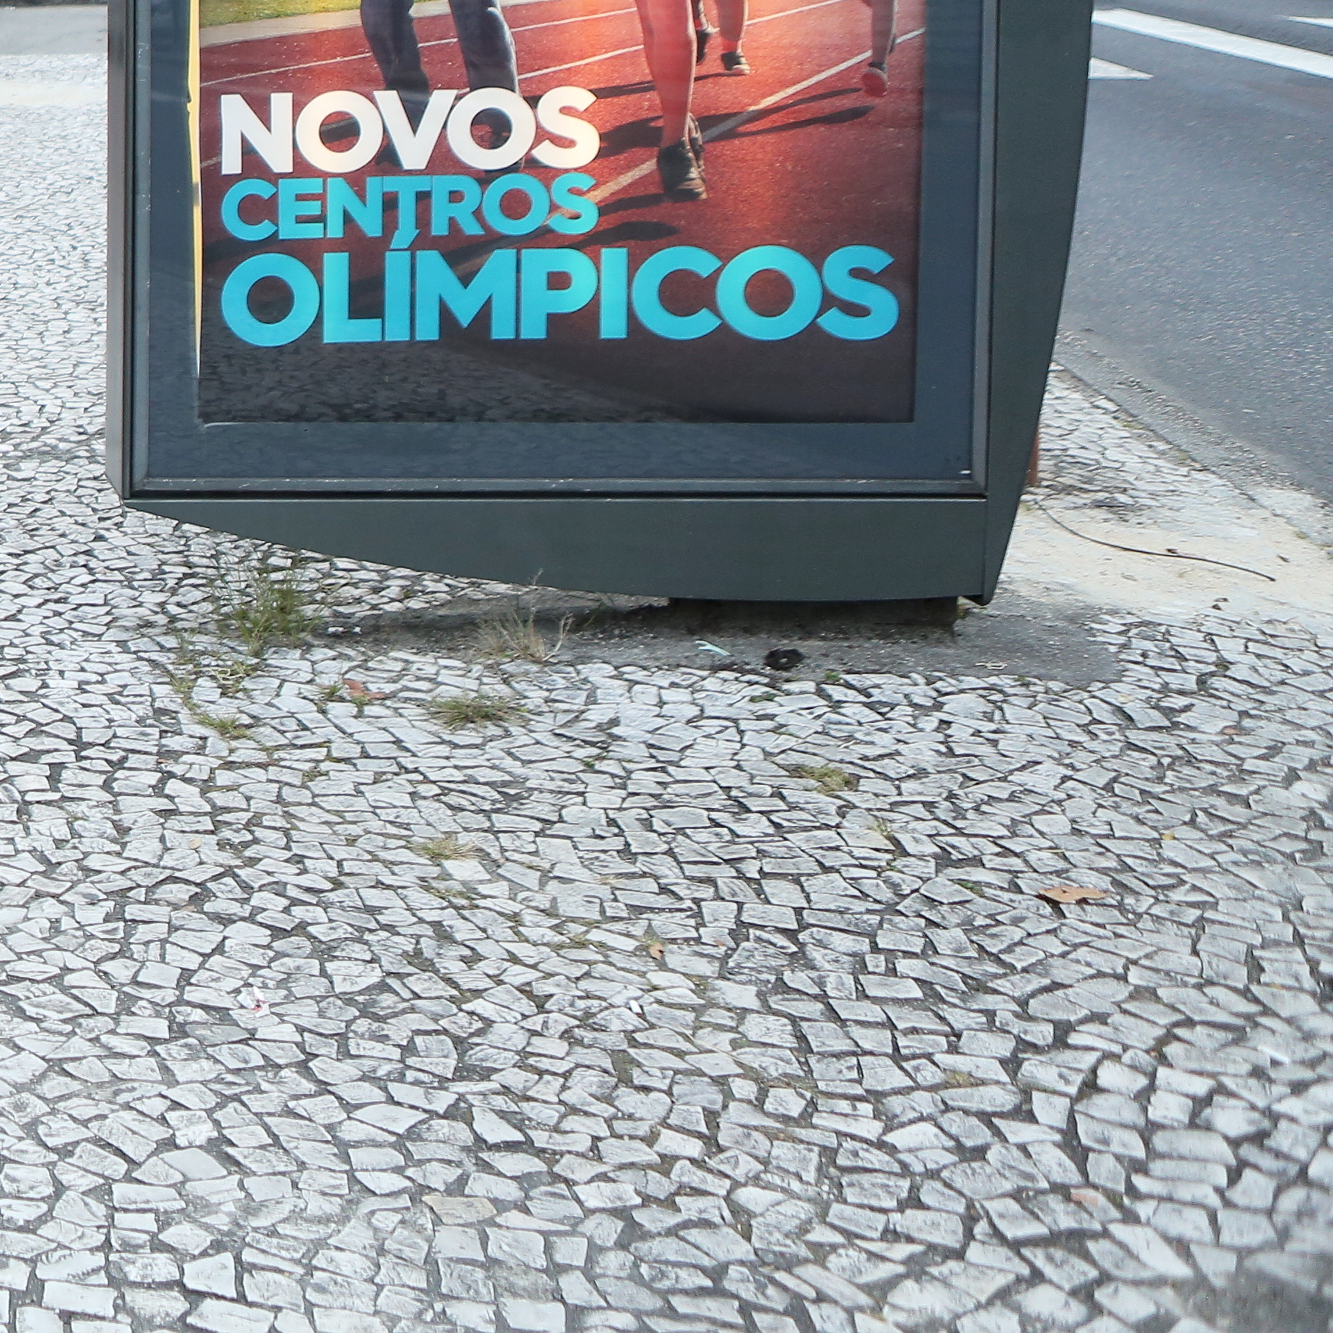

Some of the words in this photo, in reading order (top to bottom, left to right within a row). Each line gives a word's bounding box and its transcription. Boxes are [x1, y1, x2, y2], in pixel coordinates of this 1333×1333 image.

[219, 85, 601, 176] NOVOS
[220, 170, 600, 242] CENTROS
[220, 228, 901, 347] OLÍMPICOS
